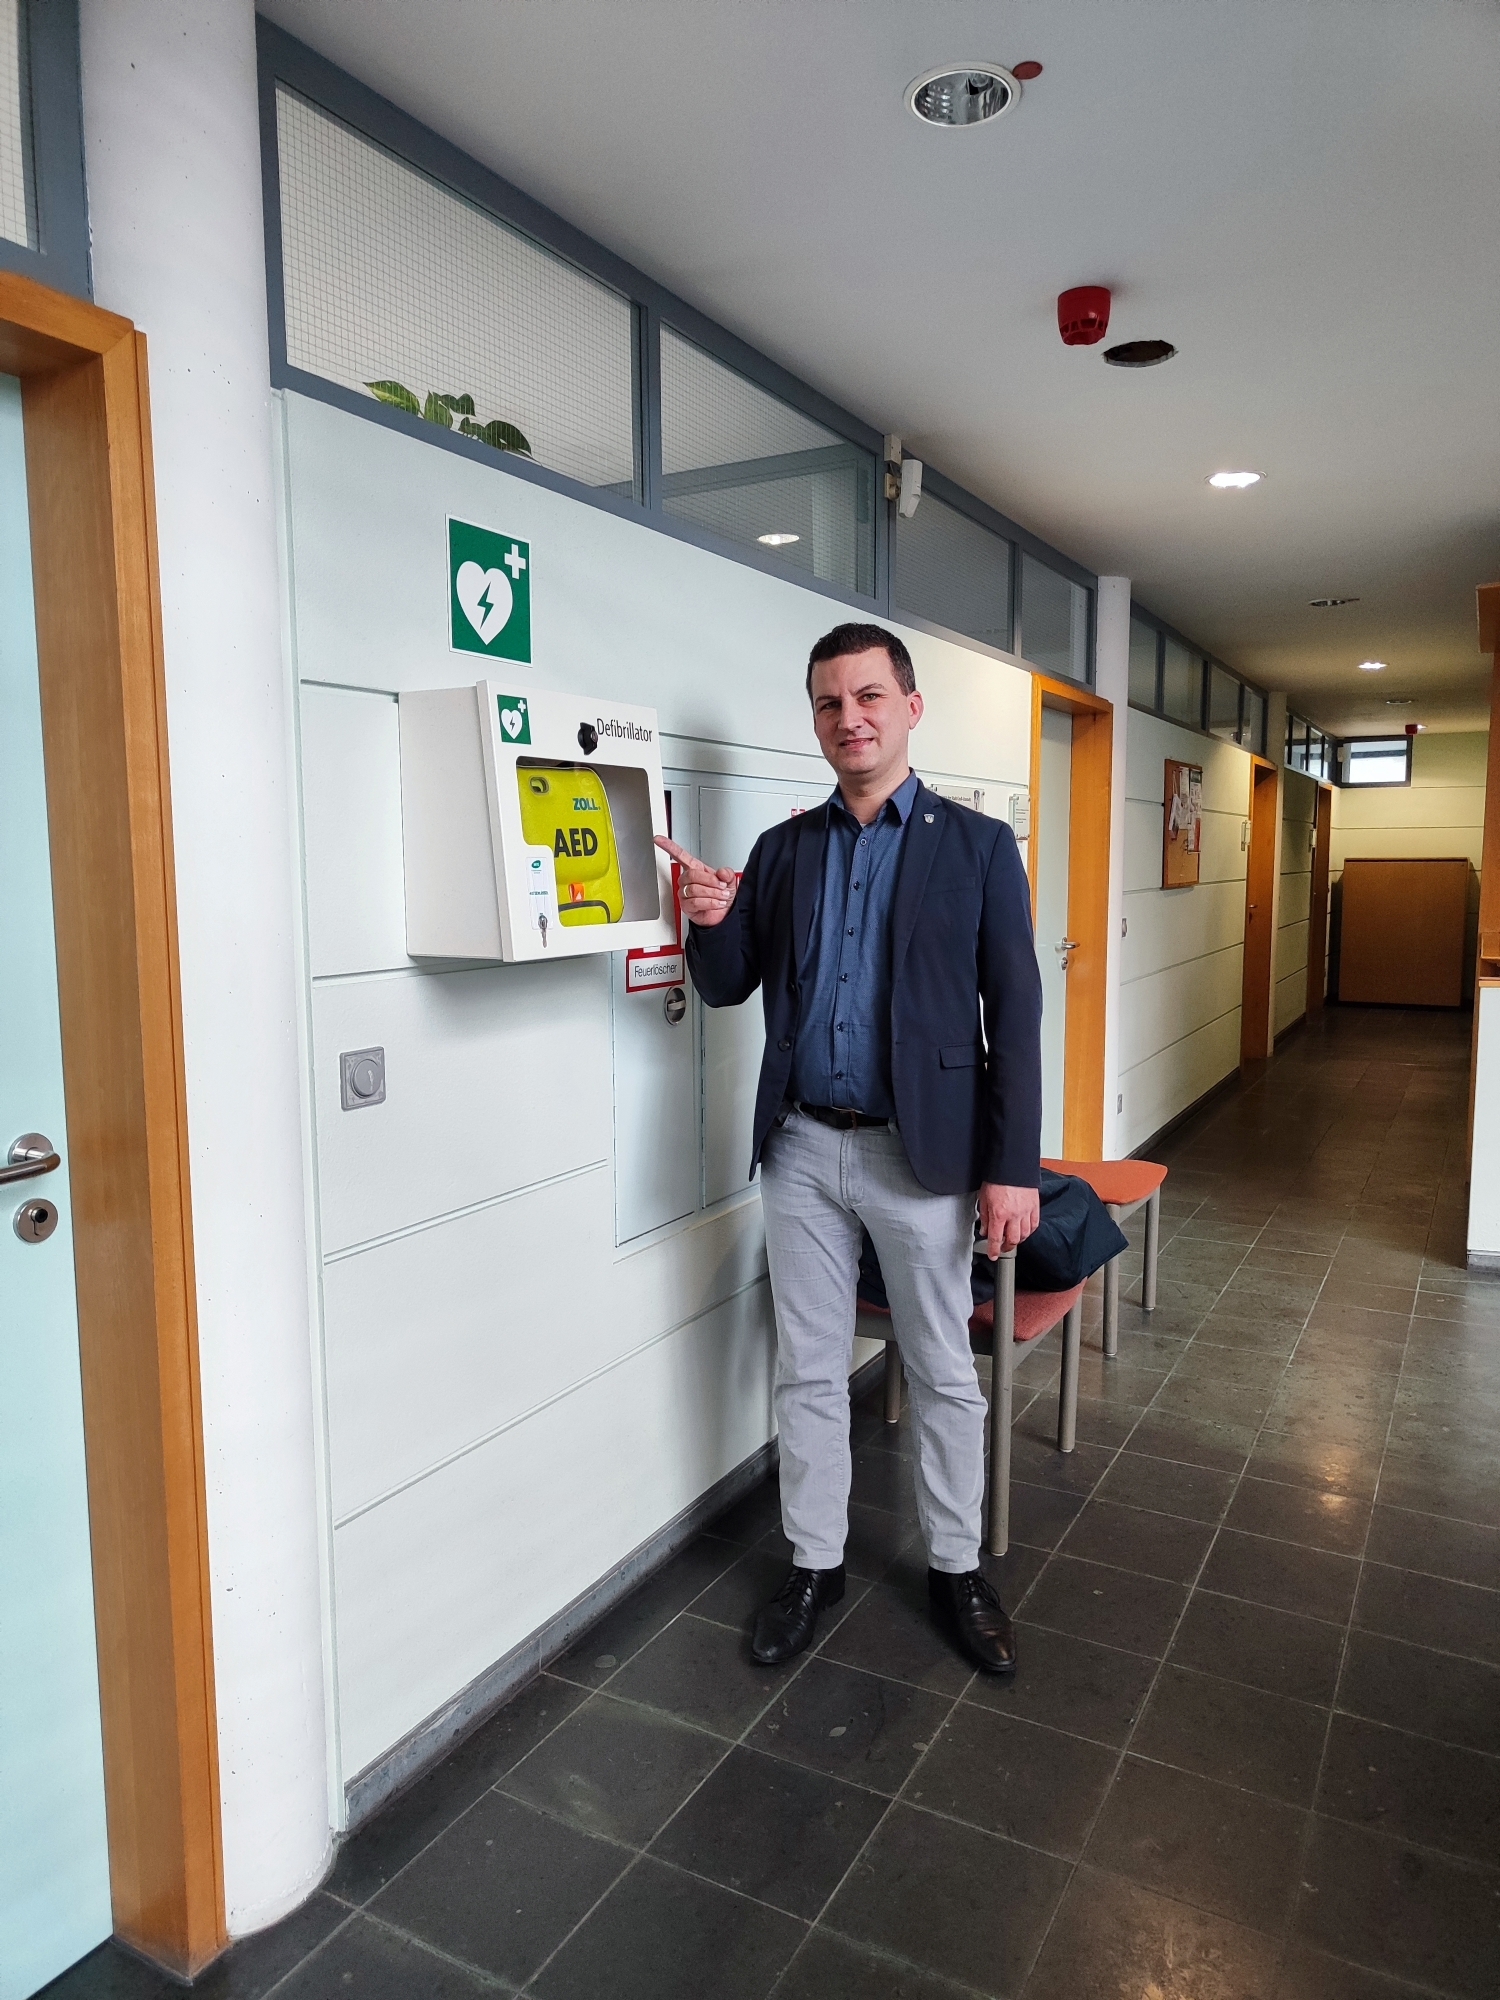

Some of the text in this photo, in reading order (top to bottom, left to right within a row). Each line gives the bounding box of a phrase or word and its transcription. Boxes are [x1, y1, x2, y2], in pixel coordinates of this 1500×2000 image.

[596, 717, 653, 743] Defibrillator
[572, 797, 600, 811] ZOLL
[554, 827, 599, 858] AED
[634, 962, 678, 978] Feuerlöscher
